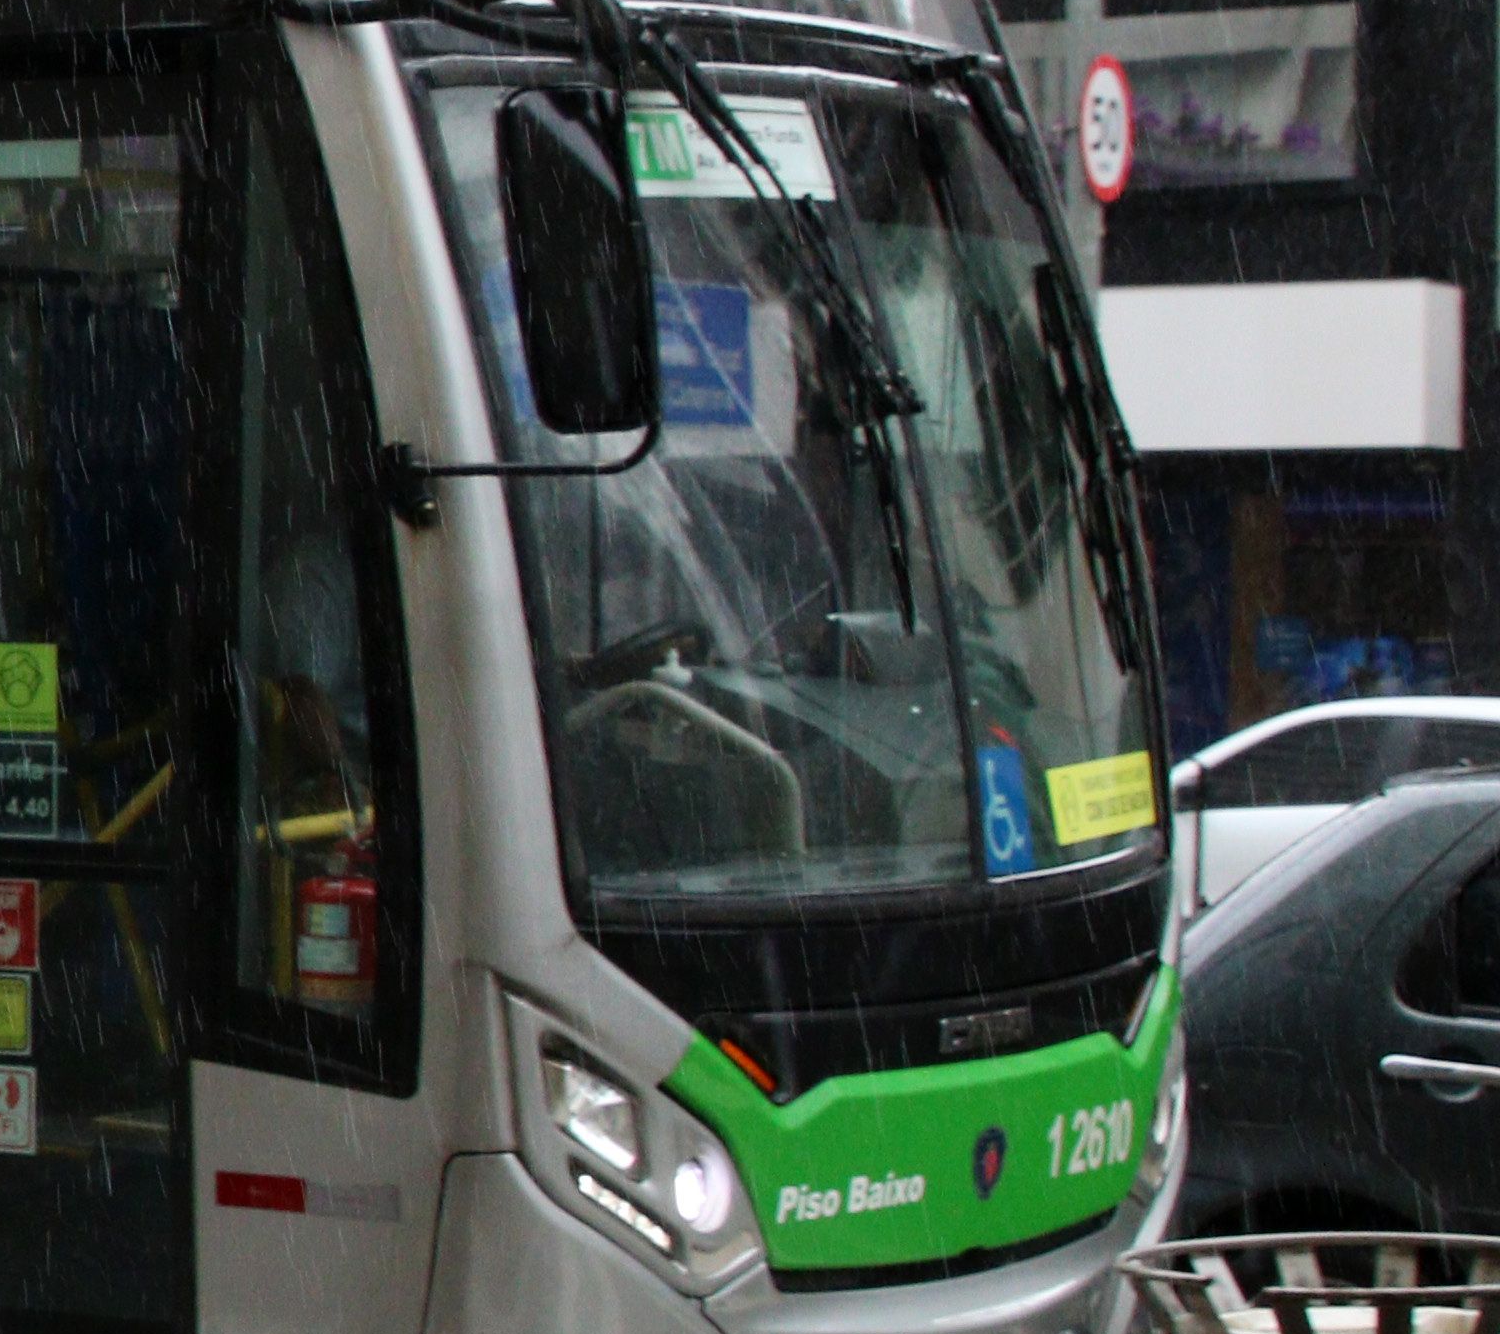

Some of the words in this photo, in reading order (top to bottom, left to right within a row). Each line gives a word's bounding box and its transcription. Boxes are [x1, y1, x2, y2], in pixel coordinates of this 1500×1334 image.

[1092, 95, 1119, 153] 50
[5, 795, 49, 817] 4,40
[775, 1183, 842, 1224] Piso
[847, 1170, 926, 1214] Baixo
